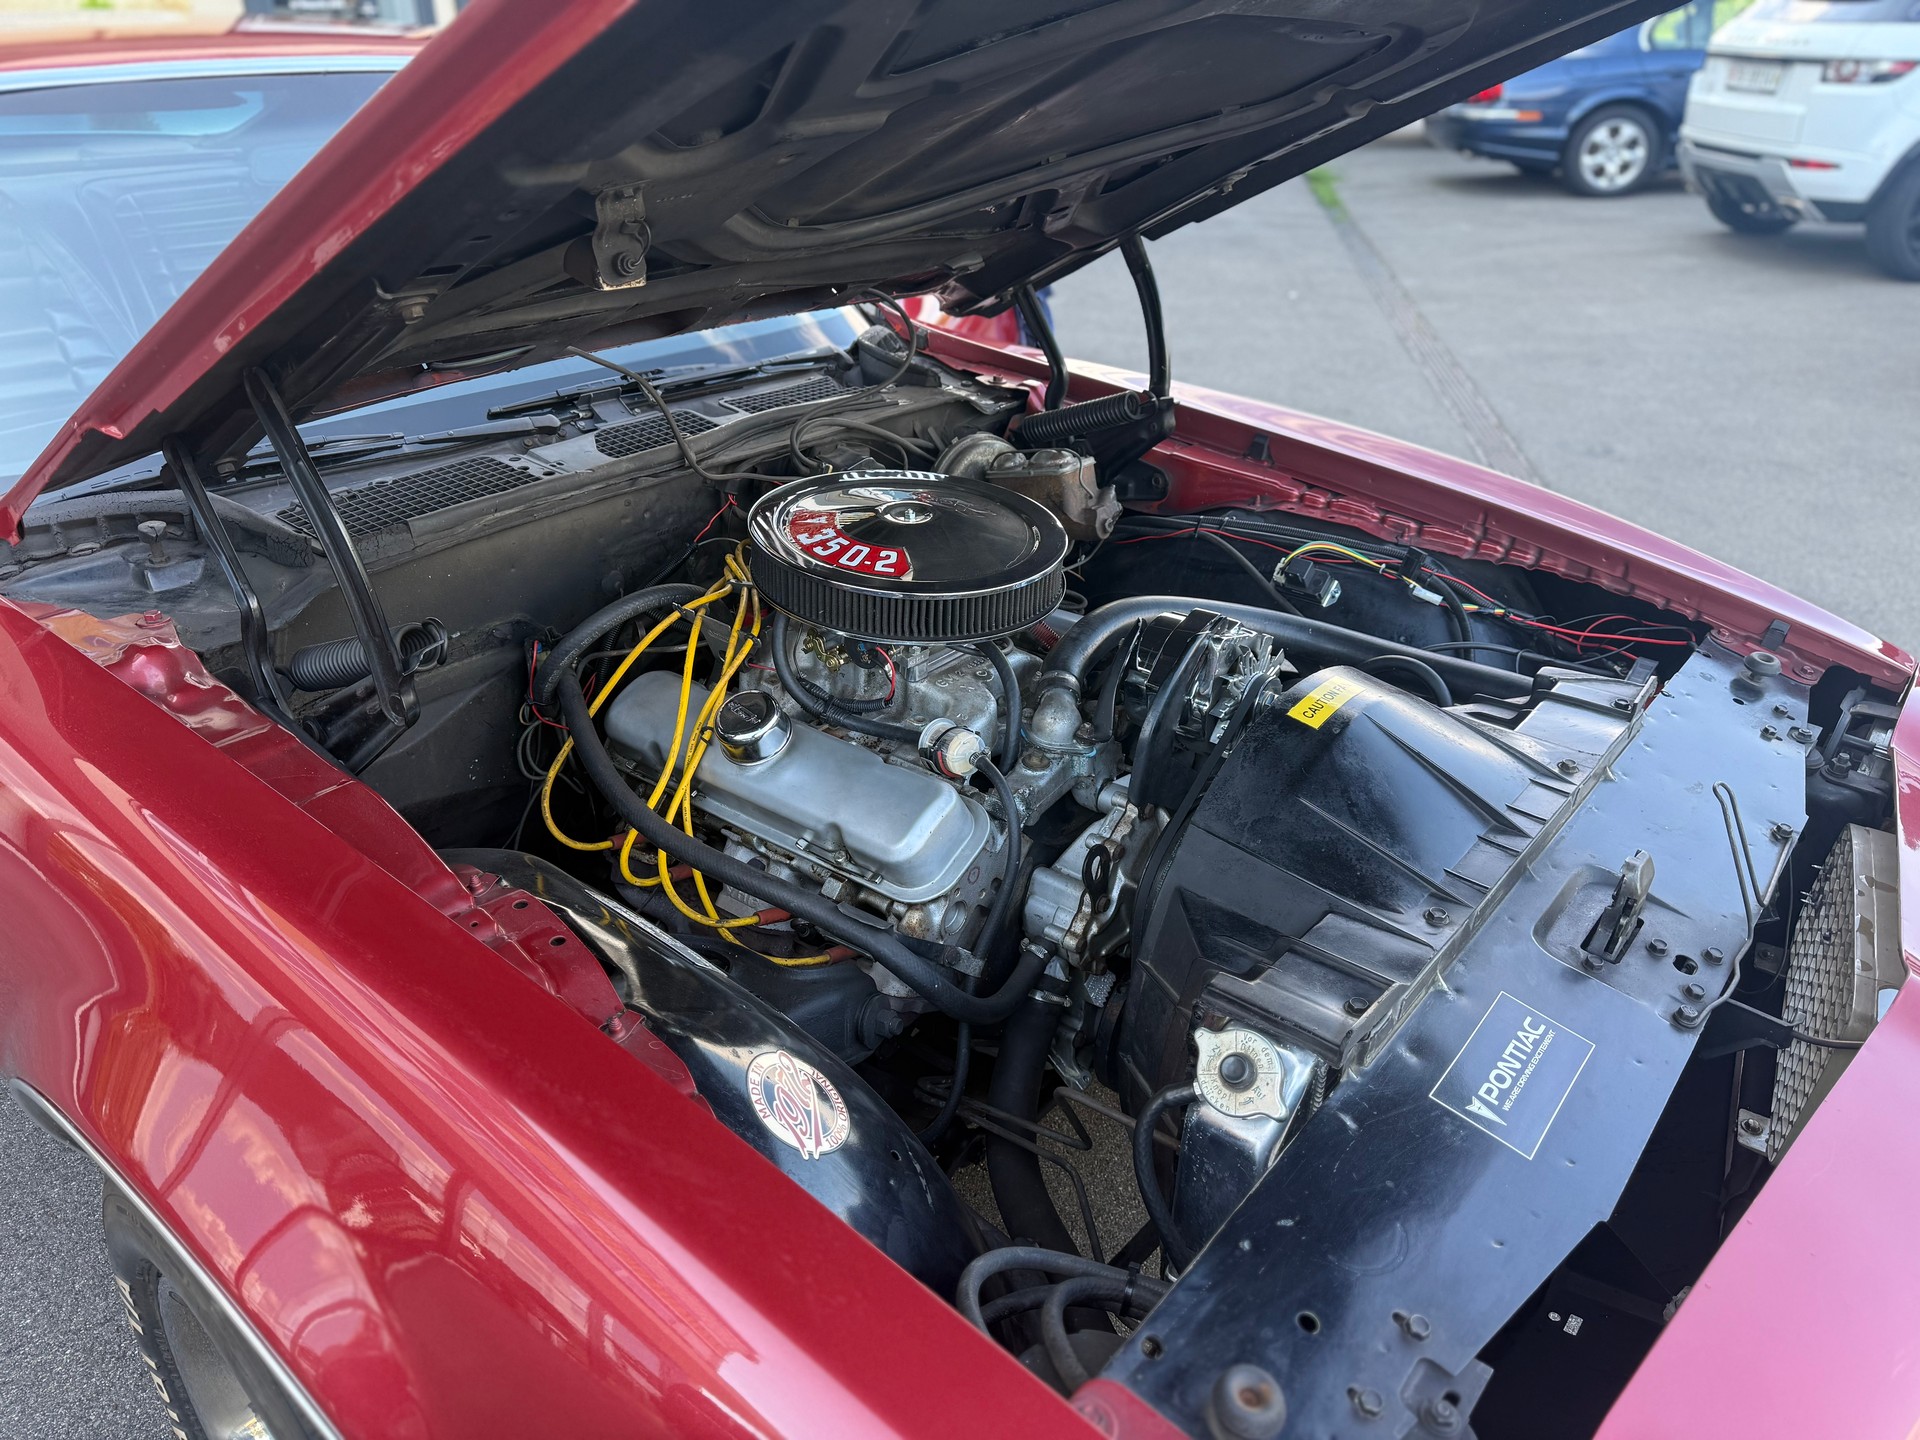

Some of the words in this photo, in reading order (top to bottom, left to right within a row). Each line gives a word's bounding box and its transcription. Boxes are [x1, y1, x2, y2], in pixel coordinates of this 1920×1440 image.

[797, 528, 897, 573] 350-2
[1302, 689, 1340, 719] CAUTION
[1243, 1032, 1258, 1044] Vor
[750, 1061, 766, 1076] IN
[1478, 1016, 1546, 1105] PONTIAC
[1502, 1099, 1513, 1112] WE
[1508, 1085, 1522, 1101] ARE
[1516, 1062, 1536, 1087] DRIVING
[1531, 1030, 1556, 1065] EXCITEMENT
[749, 1078, 771, 1120] MADE
[810, 1067, 848, 1123] ORIGINAL
[1200, 1079, 1231, 1113] drücken
[825, 1121, 848, 1149] 100%
